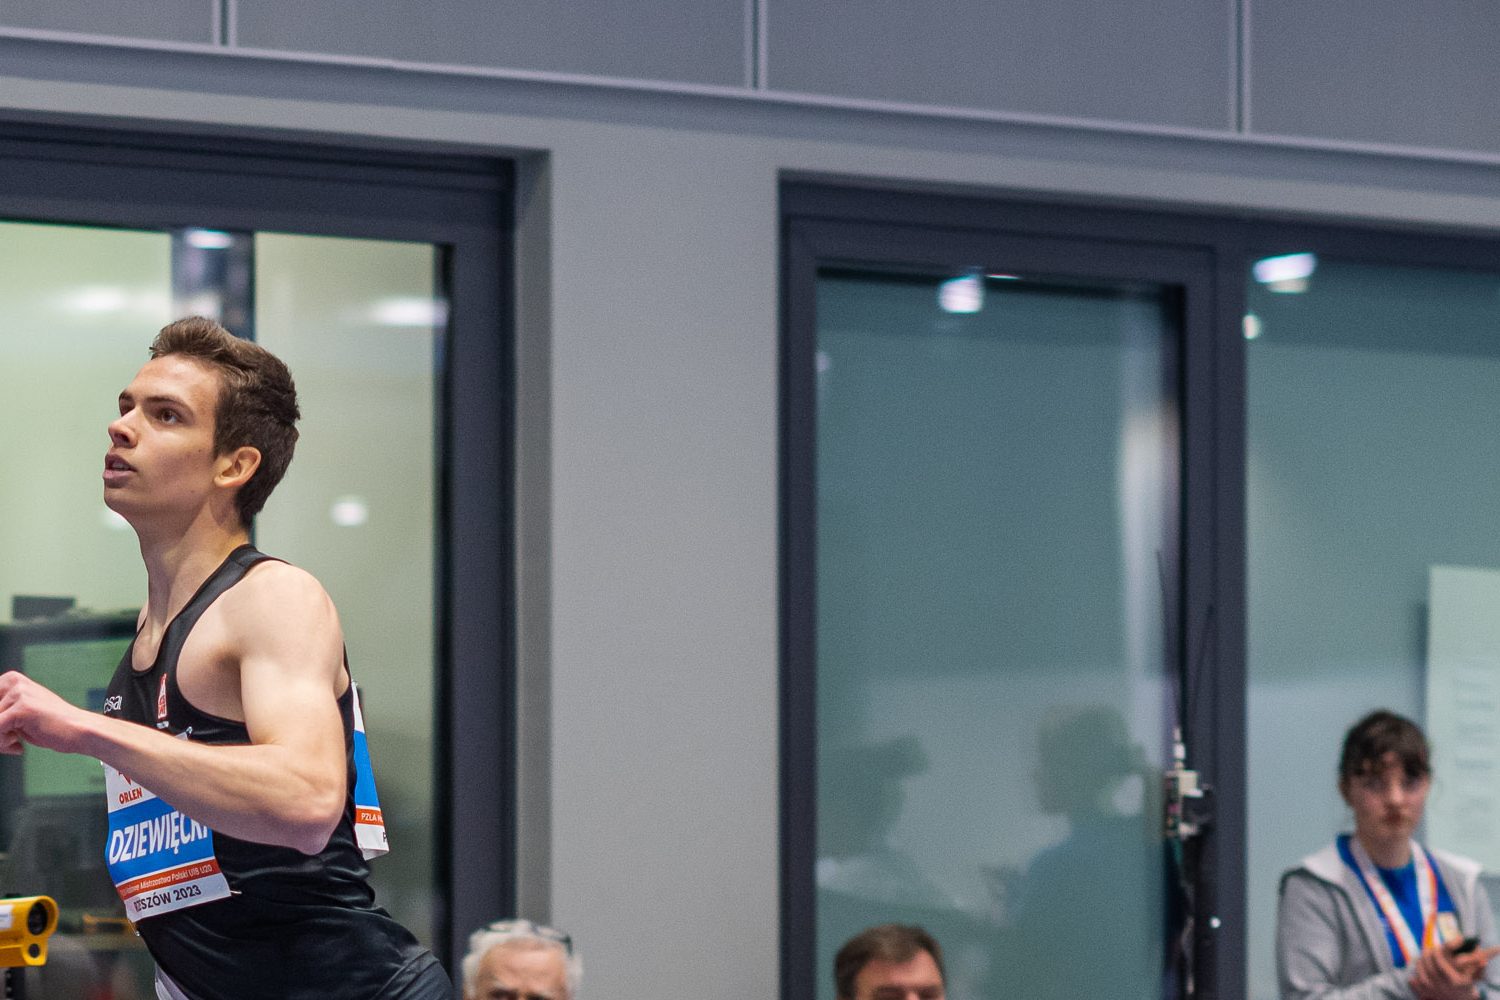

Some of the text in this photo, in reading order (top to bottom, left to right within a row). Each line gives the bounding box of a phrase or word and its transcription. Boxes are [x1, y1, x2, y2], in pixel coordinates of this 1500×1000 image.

[119, 788, 142, 804] ORLEN
[361, 812, 377, 822] PZLA
[171, 869, 189, 881] Polski
[173, 884, 202, 901] 2023
